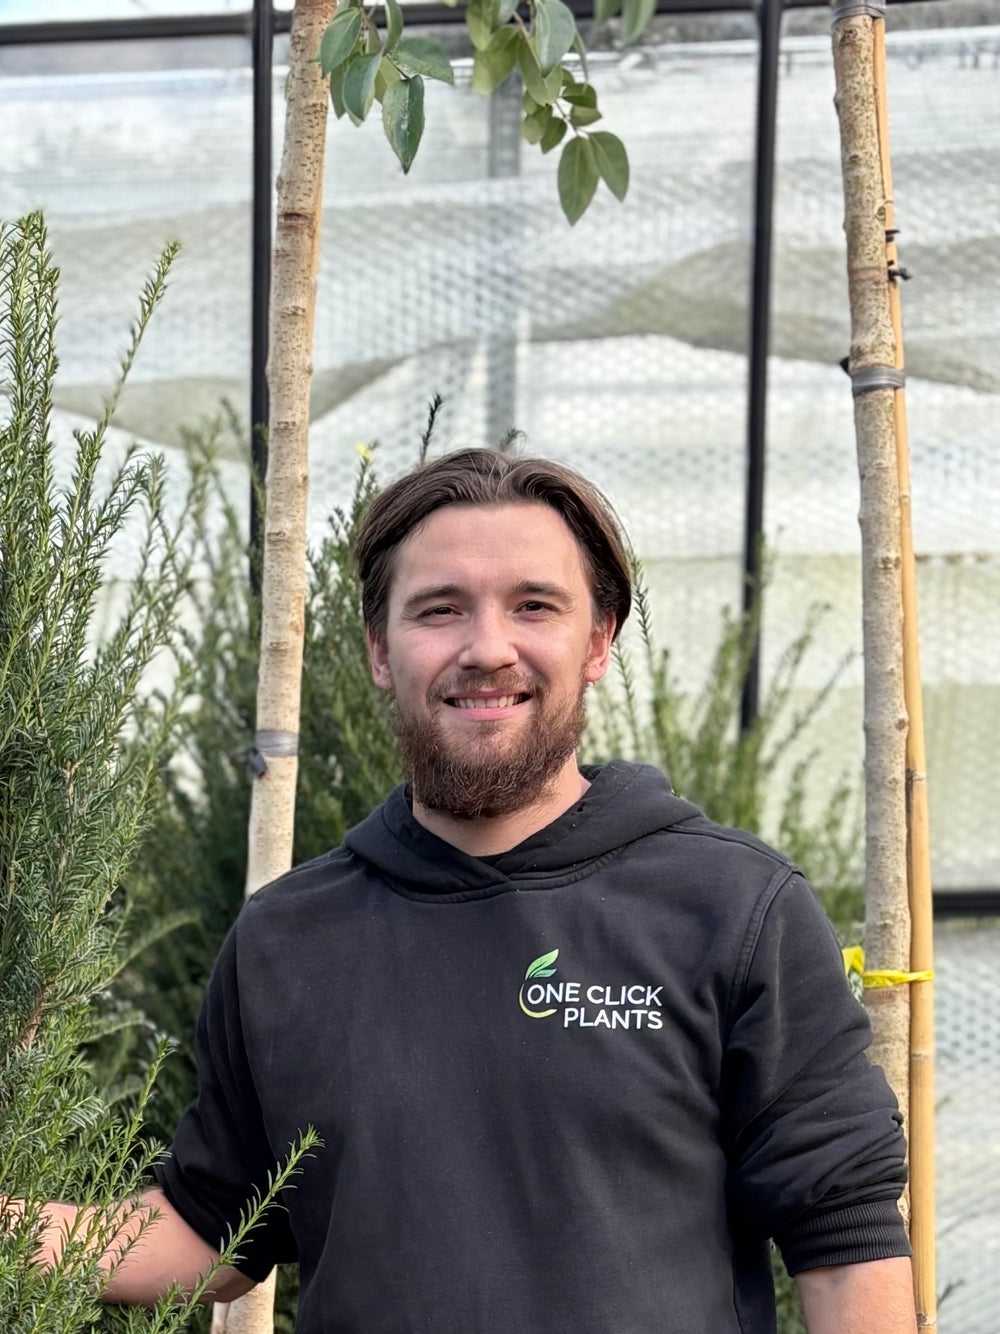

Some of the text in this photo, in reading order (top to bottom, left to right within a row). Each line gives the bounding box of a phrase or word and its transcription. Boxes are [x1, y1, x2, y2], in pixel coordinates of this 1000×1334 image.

[527, 982, 664, 1006] ONE CLICK
[563, 1007, 664, 1030] PLANTS
